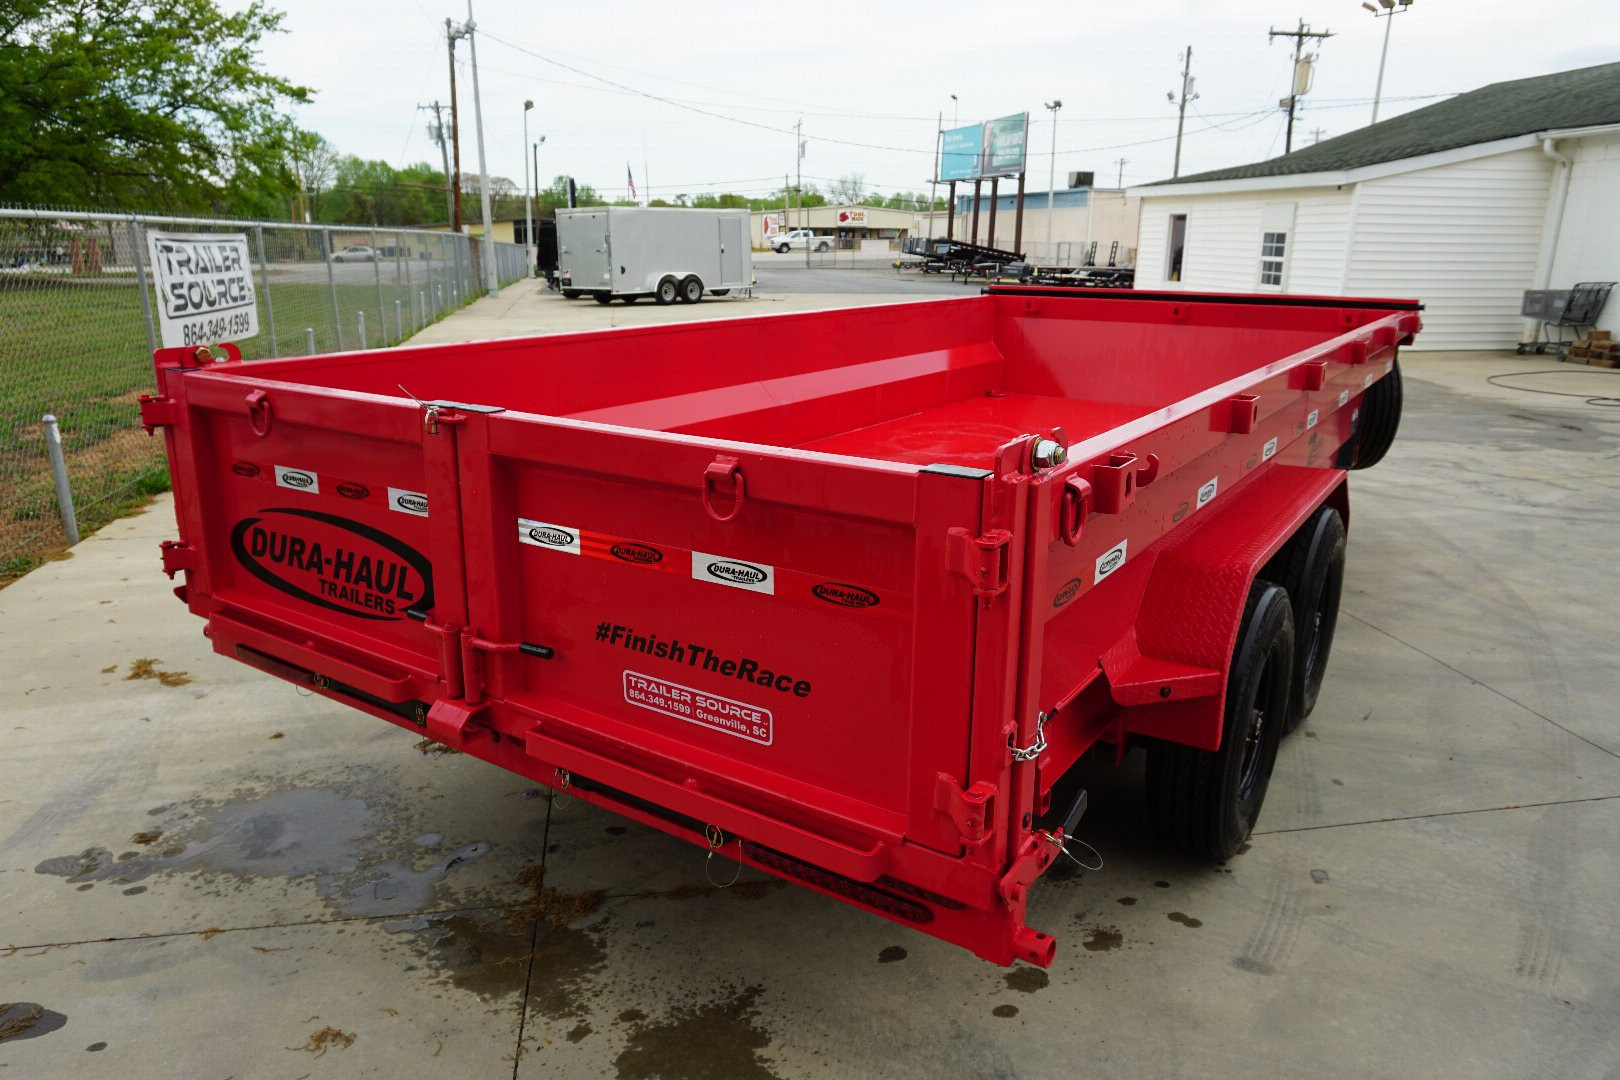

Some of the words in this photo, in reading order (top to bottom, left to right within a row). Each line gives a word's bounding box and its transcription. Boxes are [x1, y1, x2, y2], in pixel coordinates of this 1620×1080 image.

[159, 244, 243, 276] TRAILER
[170, 276, 247, 313] SOURCE
[183, 312, 250, 346] 864-349-1599
[533, 529, 570, 543] DURA-HAUL
[615, 546, 657, 561] DURA-HAUL
[251, 527, 415, 601] DURA-HAUL
[713, 563, 761, 580] DURA-HAUL
[318, 578, 396, 615] TRAILERS
[819, 586, 872, 604] DURA-HAUL
[595, 621, 812, 698] #FinishTheRace
[629, 676, 692, 704] TRAILER
[695, 695, 763, 724] SOURCE
[629, 688, 691, 715] 864.349.1599
[696, 709, 750, 735] Greenville,
[752, 725, 767, 738] SC
